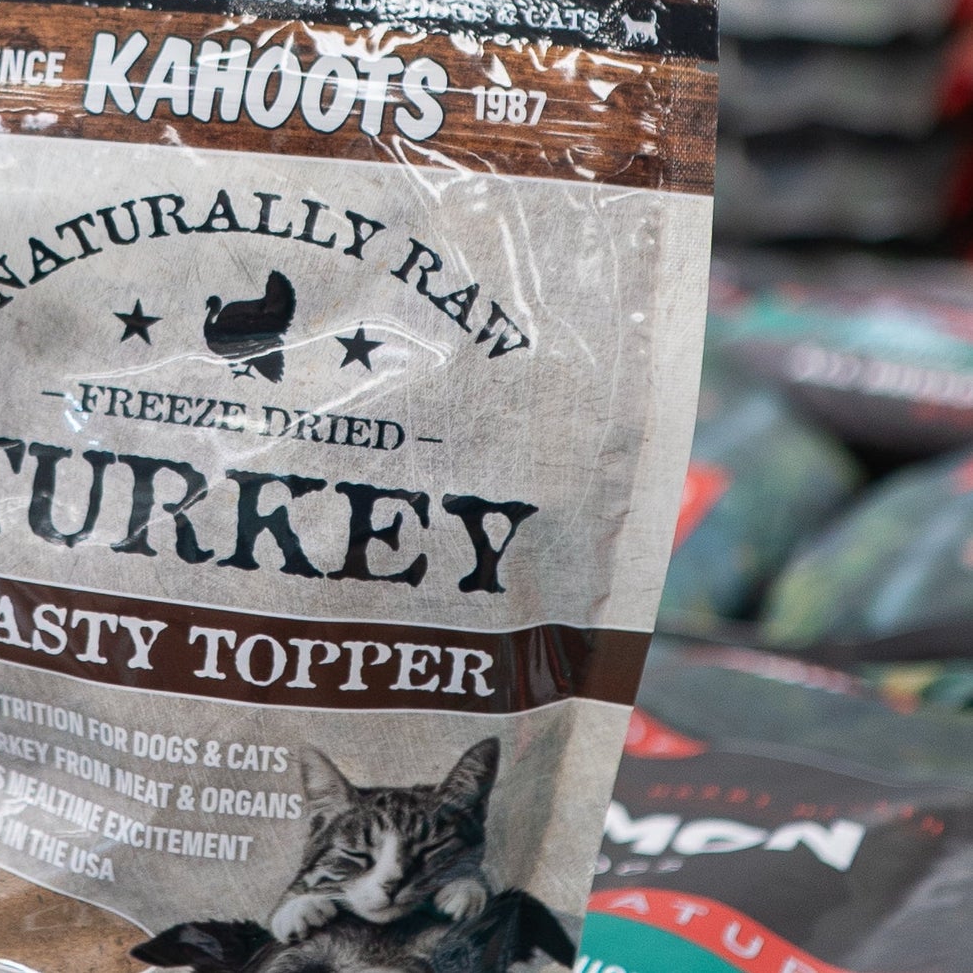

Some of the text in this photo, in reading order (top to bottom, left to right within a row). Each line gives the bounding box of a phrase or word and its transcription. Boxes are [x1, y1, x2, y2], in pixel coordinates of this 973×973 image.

[496, 3, 519, 26] &
[525, 5, 601, 33] CATS
[83, 30, 451, 142] KAHOOTS
[472, 85, 548, 126] 1987
[389, 237, 533, 360] RAW
[78, 383, 407, 451] FREEZE DRIED
[188, 625, 496, 698] TOPPER
[89, 719, 128, 753] FOR
[133, 730, 198, 767] DOGS
[203, 741, 222, 768] &
[227, 743, 289, 774] CATS
[5, 770, 104, 834] MEALTIME
[103, 809, 254, 863] EXCITEMENT
[54, 747, 112, 789] FROM
[114, 766, 174, 809] MEAT
[177, 785, 196, 812] &
[200, 785, 304, 820] ORGANS
[3, 819, 29, 851] IN
[29, 828, 69, 869] THE
[70, 848, 116, 883] USA
[604, 798, 868, 873] MON
